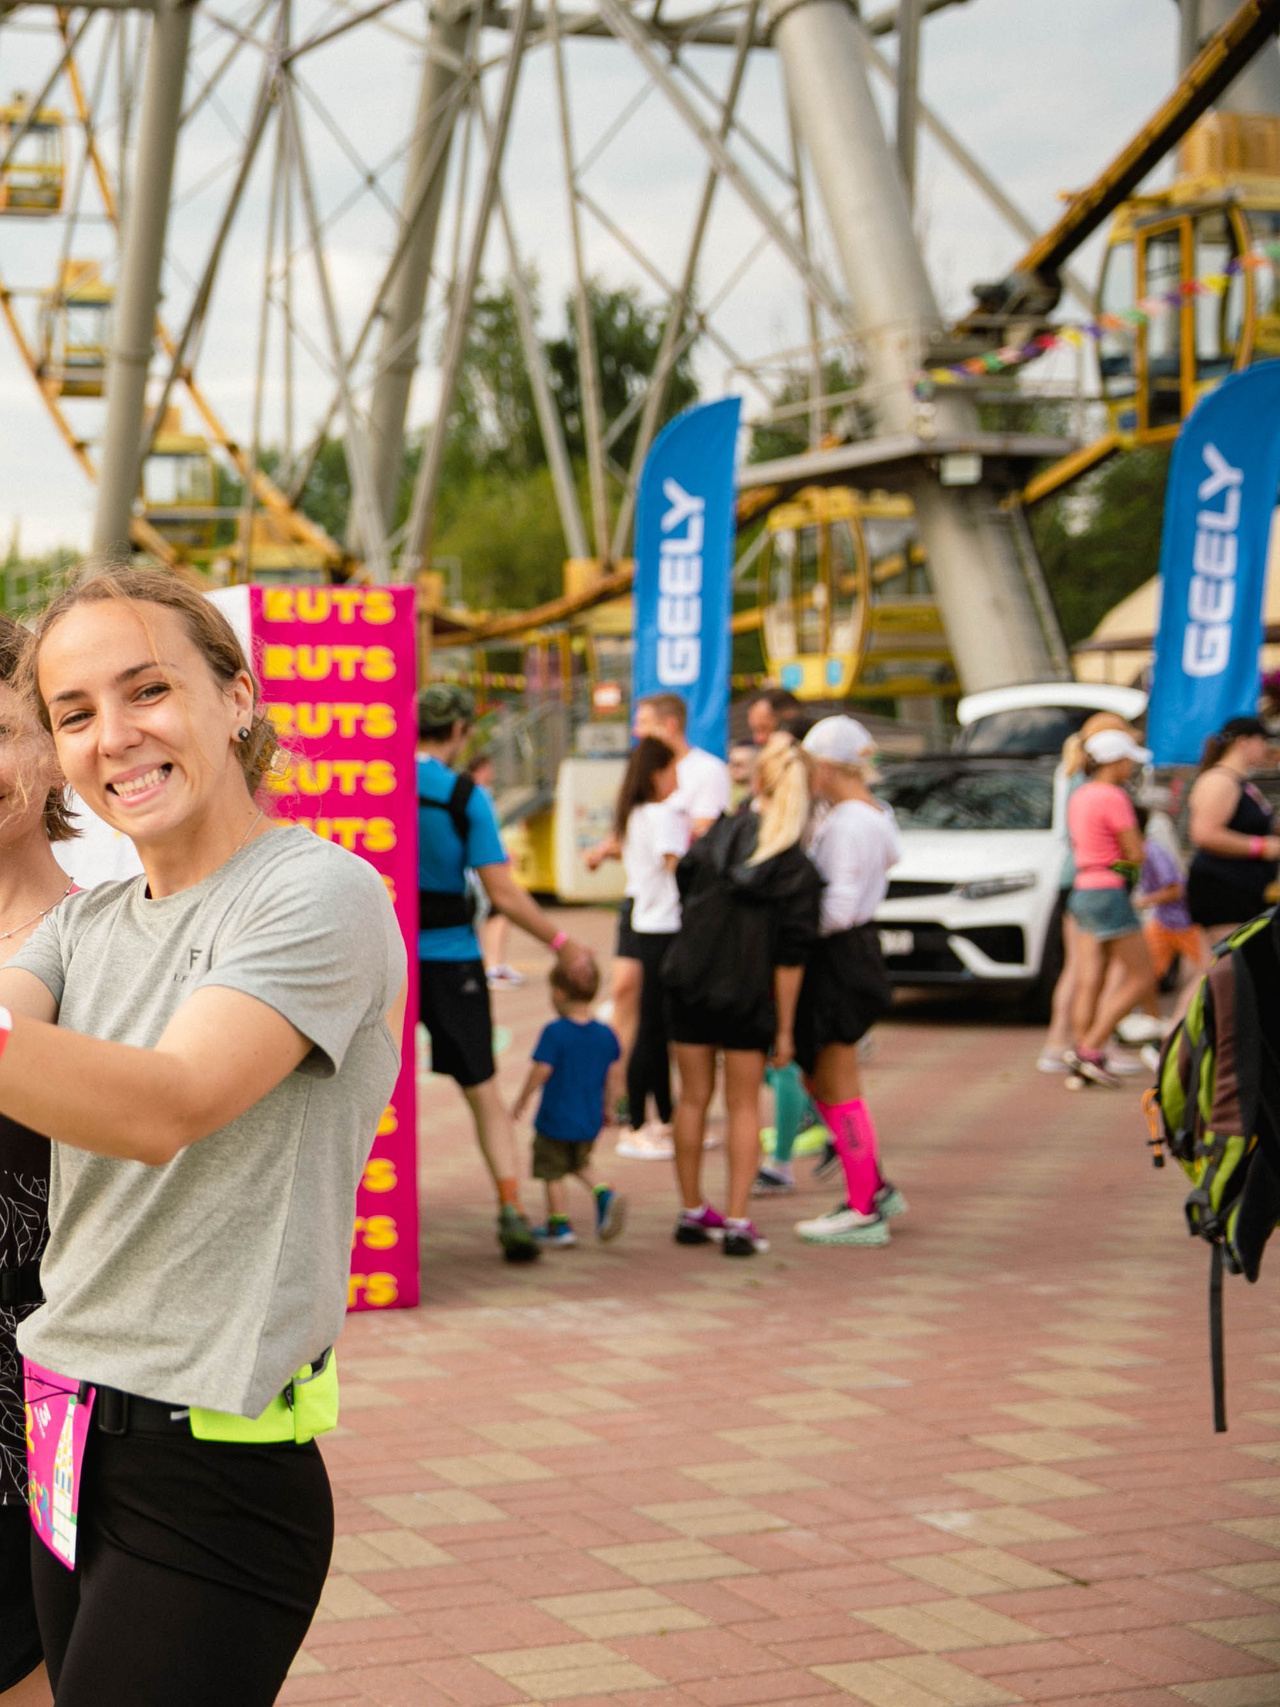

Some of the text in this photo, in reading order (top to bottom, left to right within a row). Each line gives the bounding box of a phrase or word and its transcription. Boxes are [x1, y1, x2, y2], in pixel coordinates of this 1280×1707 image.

[1182, 443, 1244, 678] GEELY
[657, 477, 705, 686] GEELY
[263, 588, 396, 625] RUTS
[263, 645, 397, 682] RUTS
[265, 702, 397, 739] RUTS
